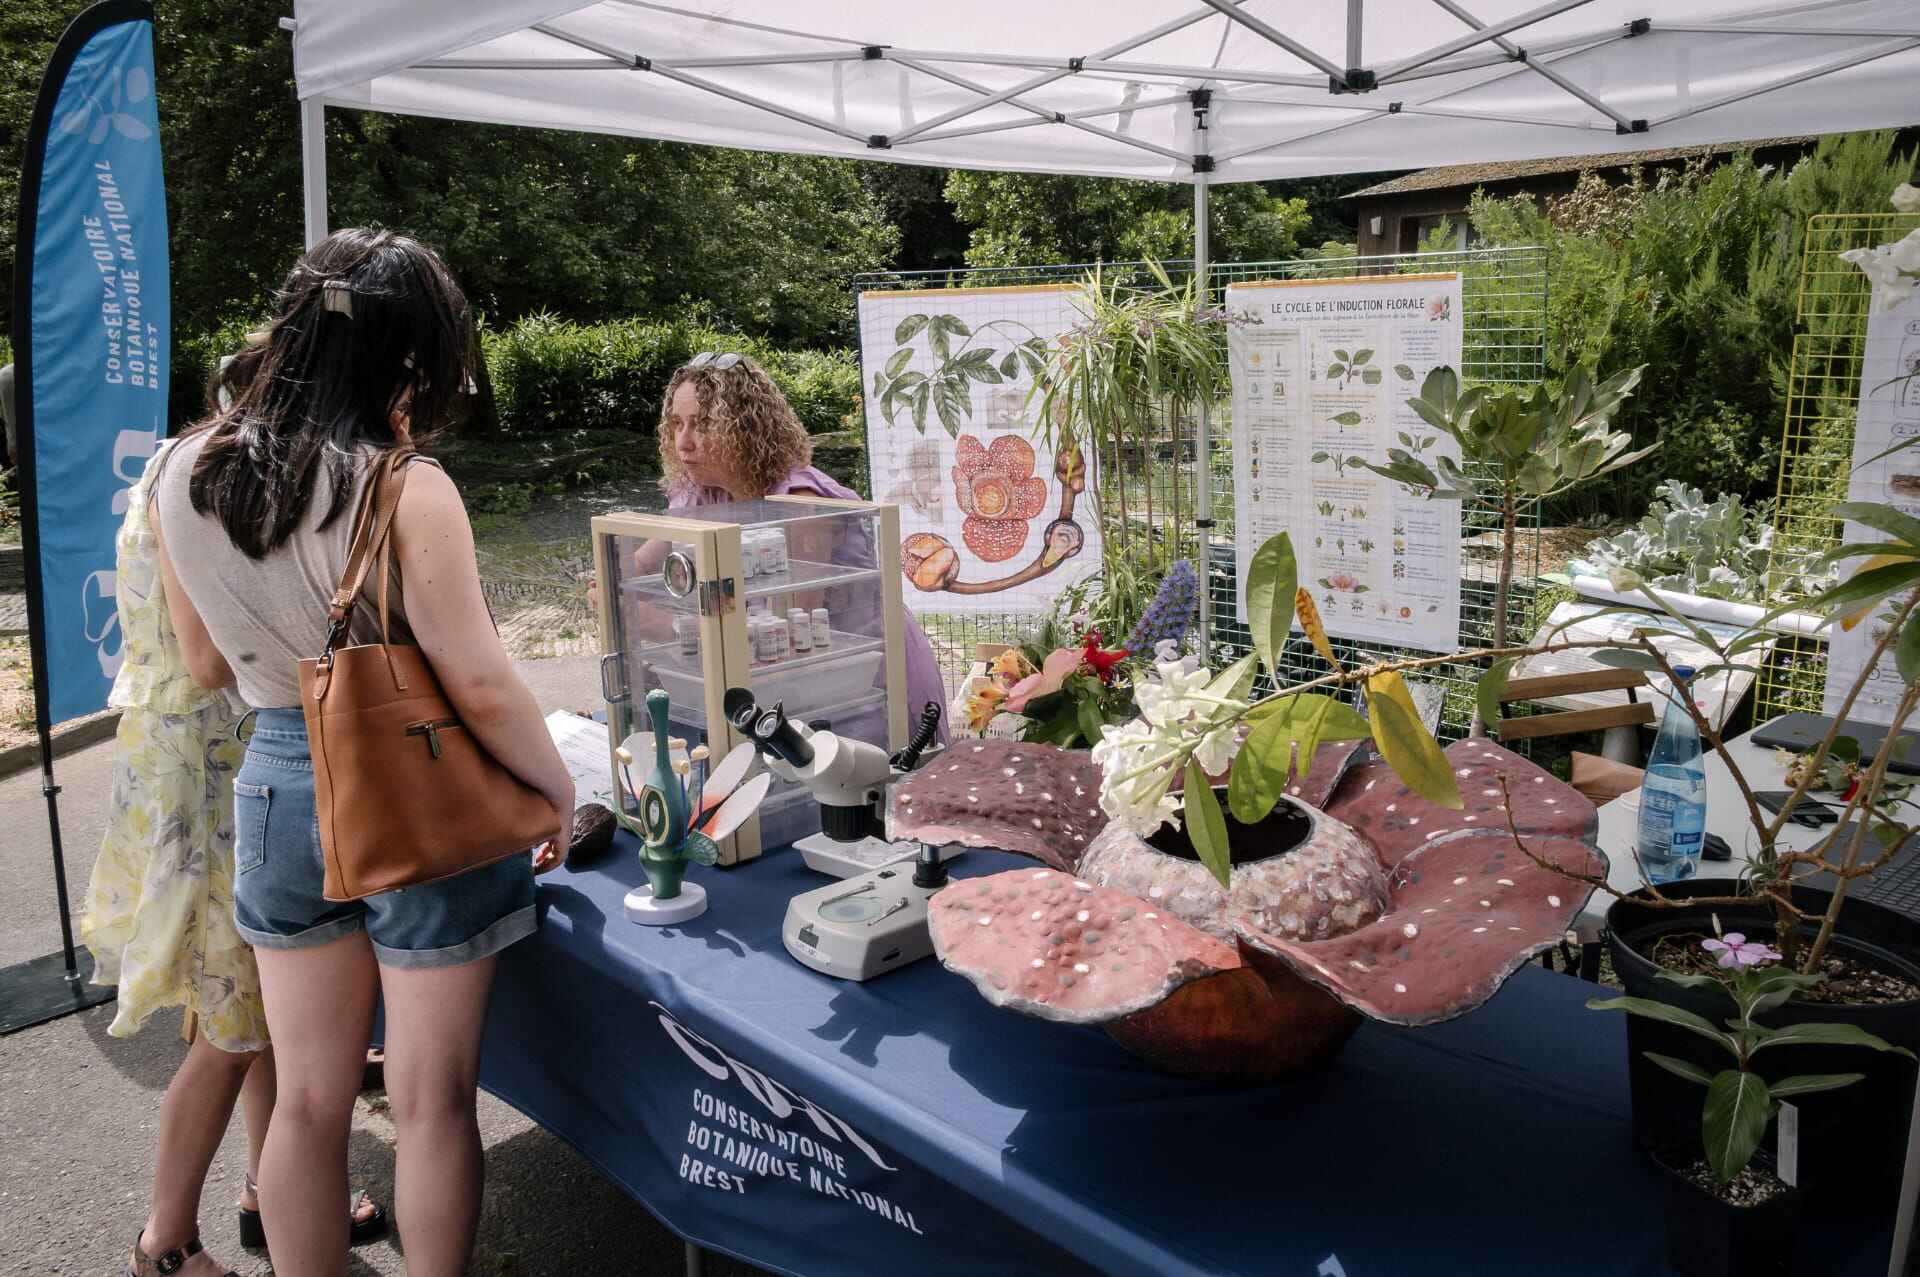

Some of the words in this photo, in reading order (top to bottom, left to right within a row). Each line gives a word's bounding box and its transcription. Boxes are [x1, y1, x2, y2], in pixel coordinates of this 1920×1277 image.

[95, 159, 137, 261] NATIONAL
[83, 215, 123, 385] CONSERVATOIRE
[120, 269, 144, 387] BOTANIQUE
[1271, 303, 1282, 314] LE
[1285, 302, 1312, 313] CYCLE
[1315, 301, 1327, 312] DE
[1329, 299, 1383, 312] L'INDUCTION
[1387, 298, 1425, 310] FLORALE
[147, 323, 159, 390] BREST
[679, 1153, 745, 1195] BREST
[687, 1120, 802, 1182] BOTANIQUE
[809, 1167, 924, 1236] NATIONAL
[693, 1088, 848, 1178] CONSERVATOIRE
